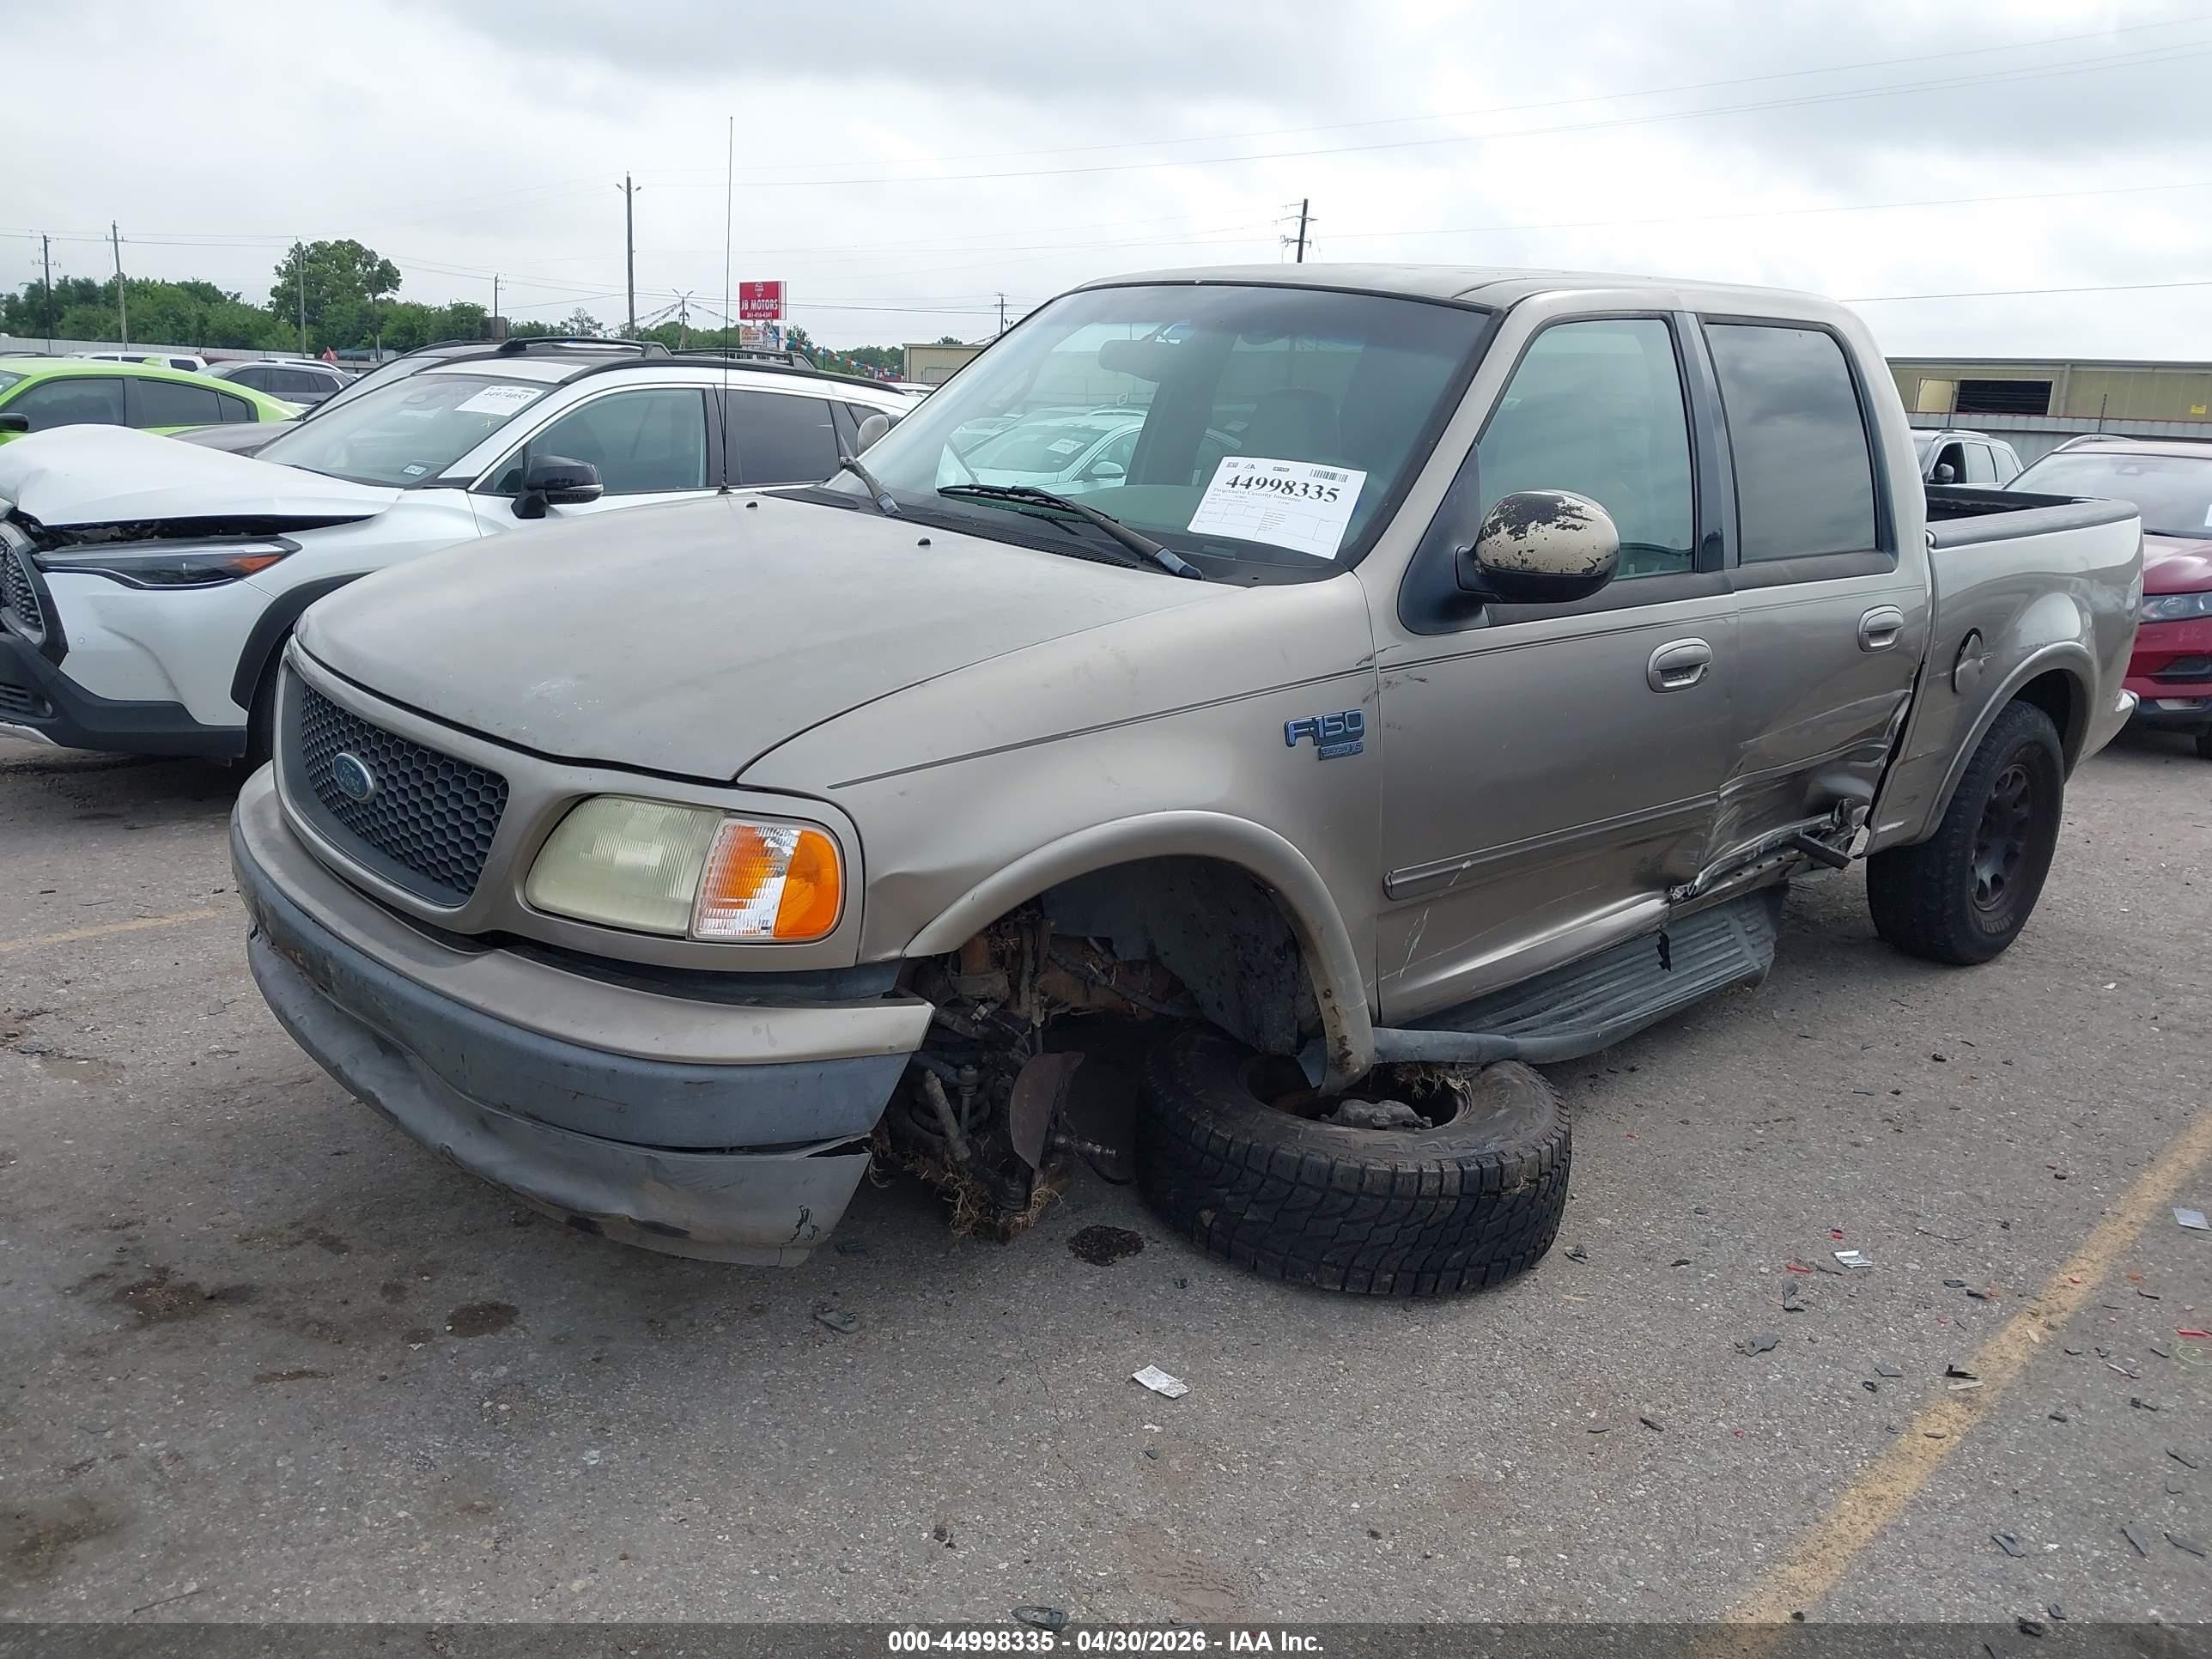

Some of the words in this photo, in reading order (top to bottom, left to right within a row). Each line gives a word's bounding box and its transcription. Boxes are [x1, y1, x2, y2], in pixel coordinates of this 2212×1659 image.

[741, 300, 749, 310] JB
[750, 299, 778, 310] MOTORS
[1225, 474, 1340, 503] 44998335
[1273, 495, 1303, 503] Insurance
